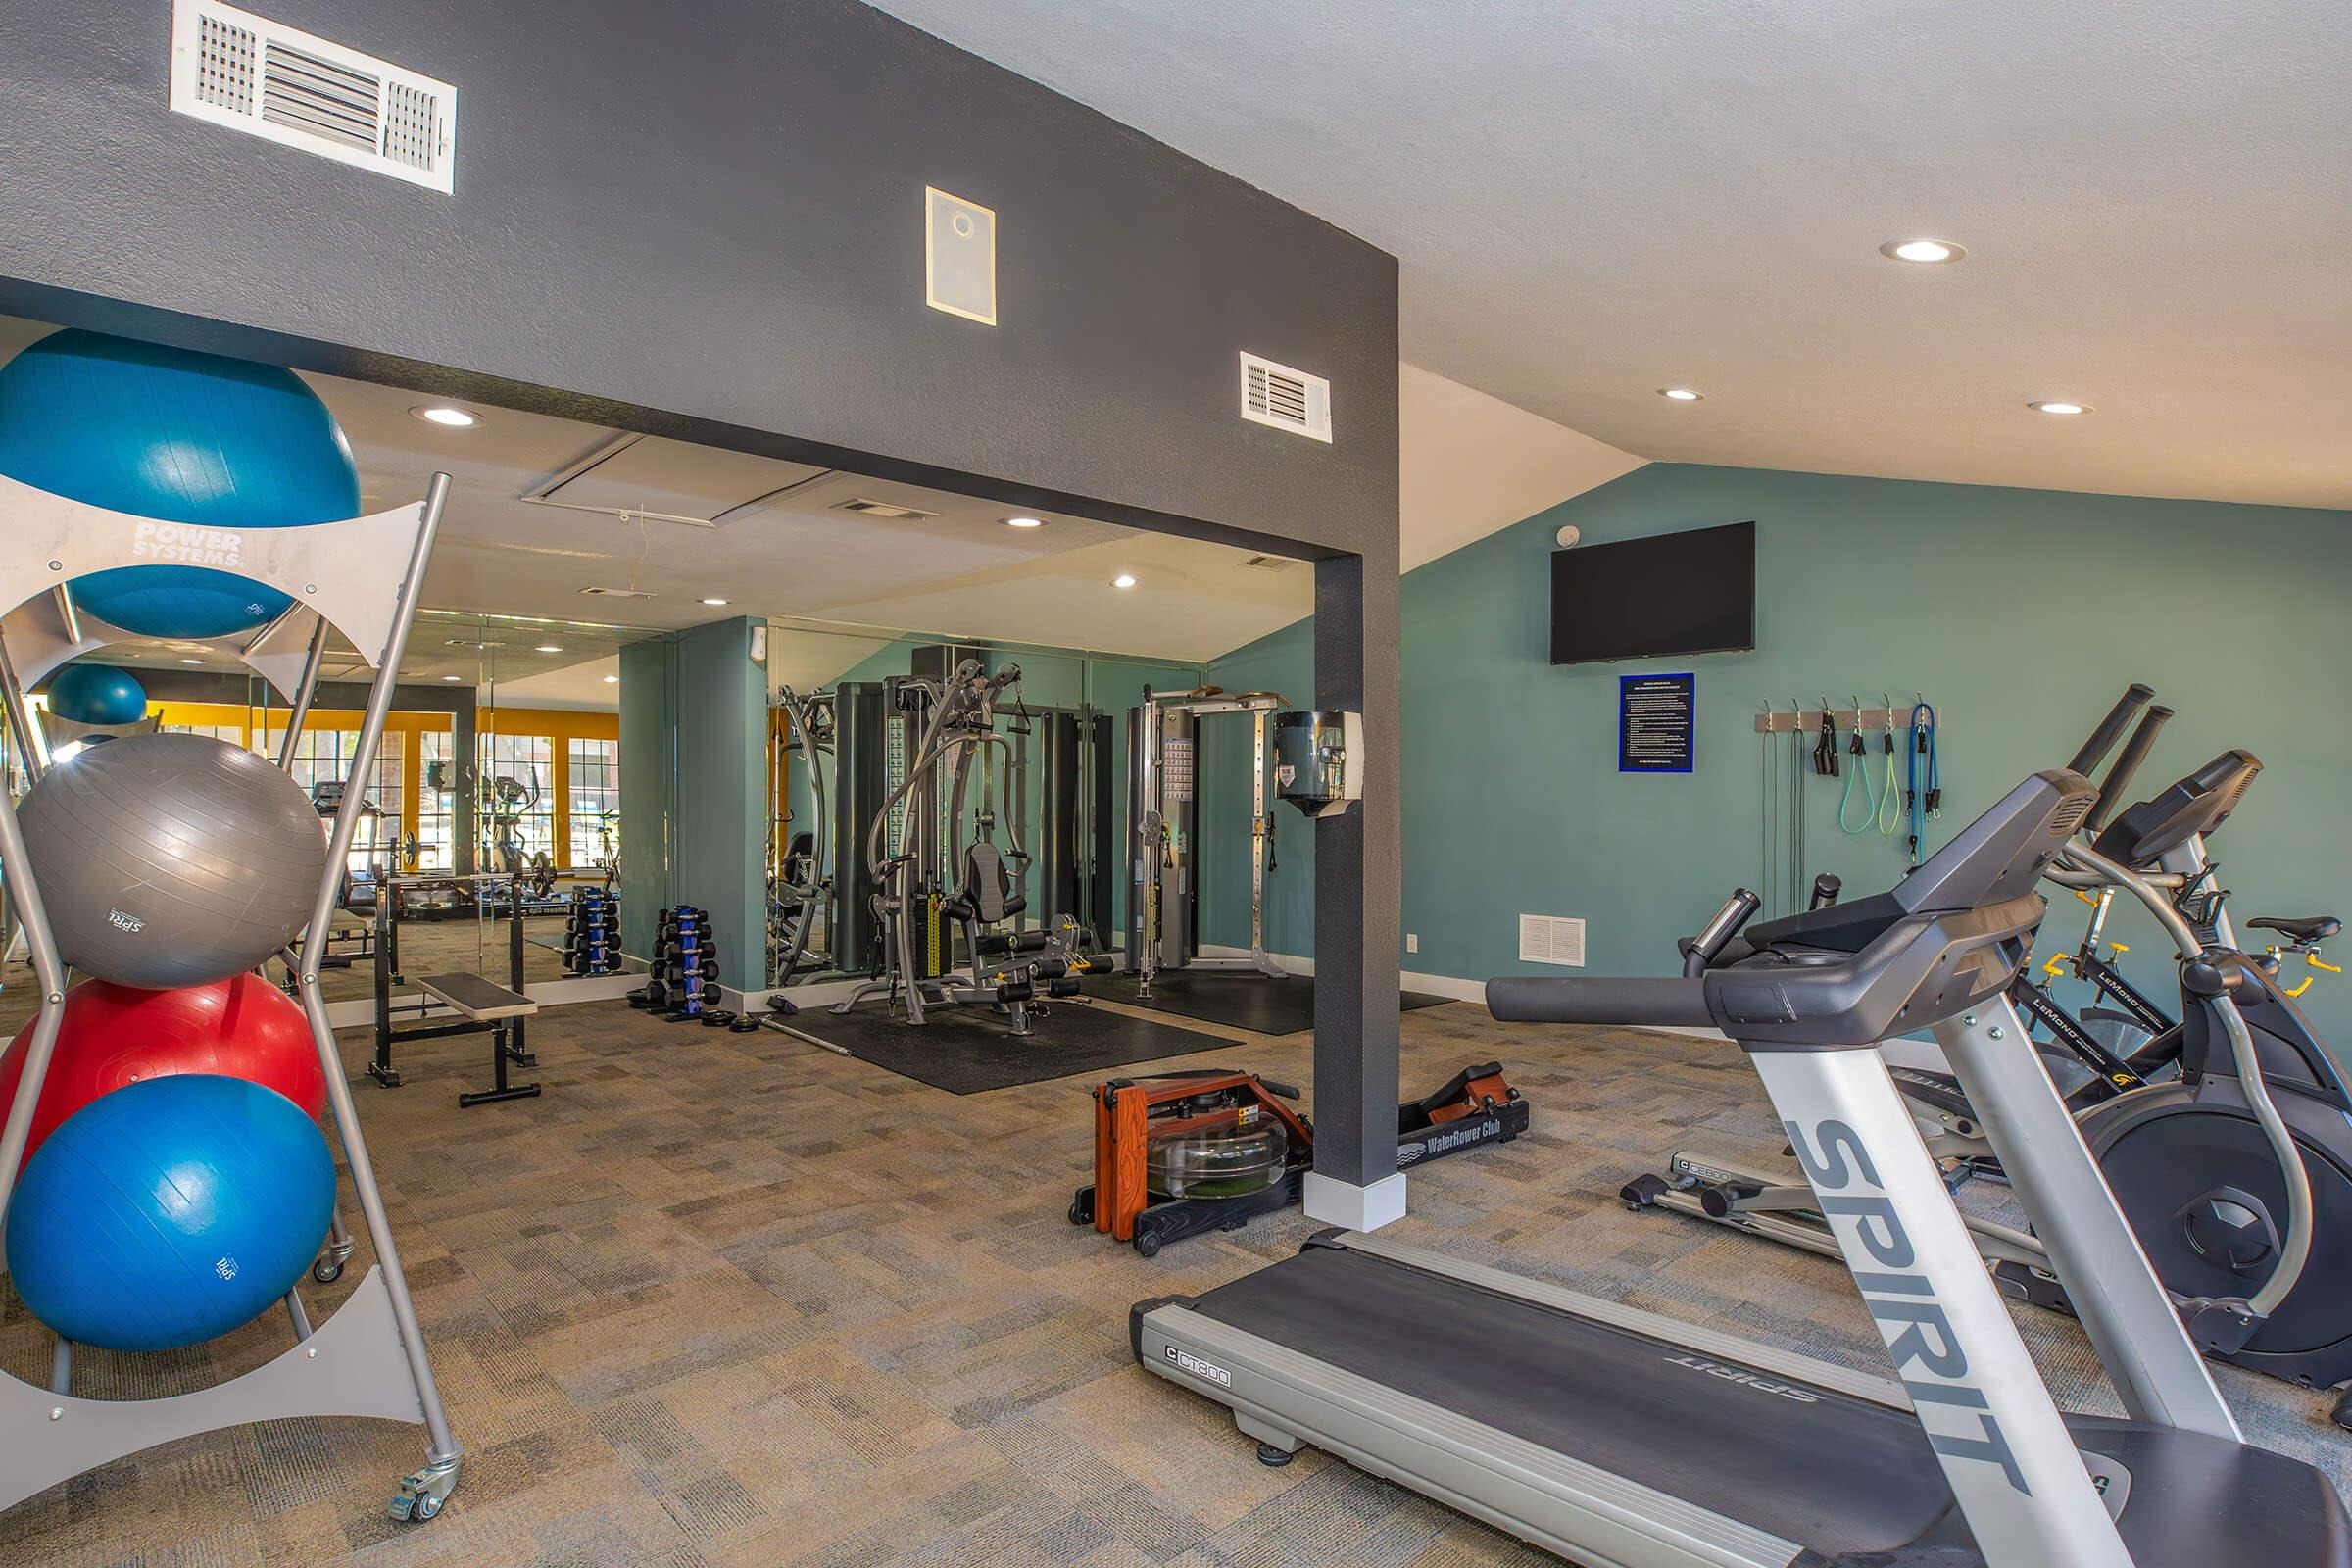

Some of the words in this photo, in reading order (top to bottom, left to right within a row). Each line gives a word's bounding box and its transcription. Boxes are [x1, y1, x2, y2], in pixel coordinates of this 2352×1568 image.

[132, 540, 239, 566] SYSTEMS
[135, 521, 242, 552] POWER
[1427, 1126, 1481, 1154] WaterRower
[1482, 1119, 1501, 1137] Club
[1783, 1119, 2033, 1497] SPIRIT
[1180, 1353, 1229, 1384] CT800
[1662, 1356, 1826, 1403] SPIRIT
